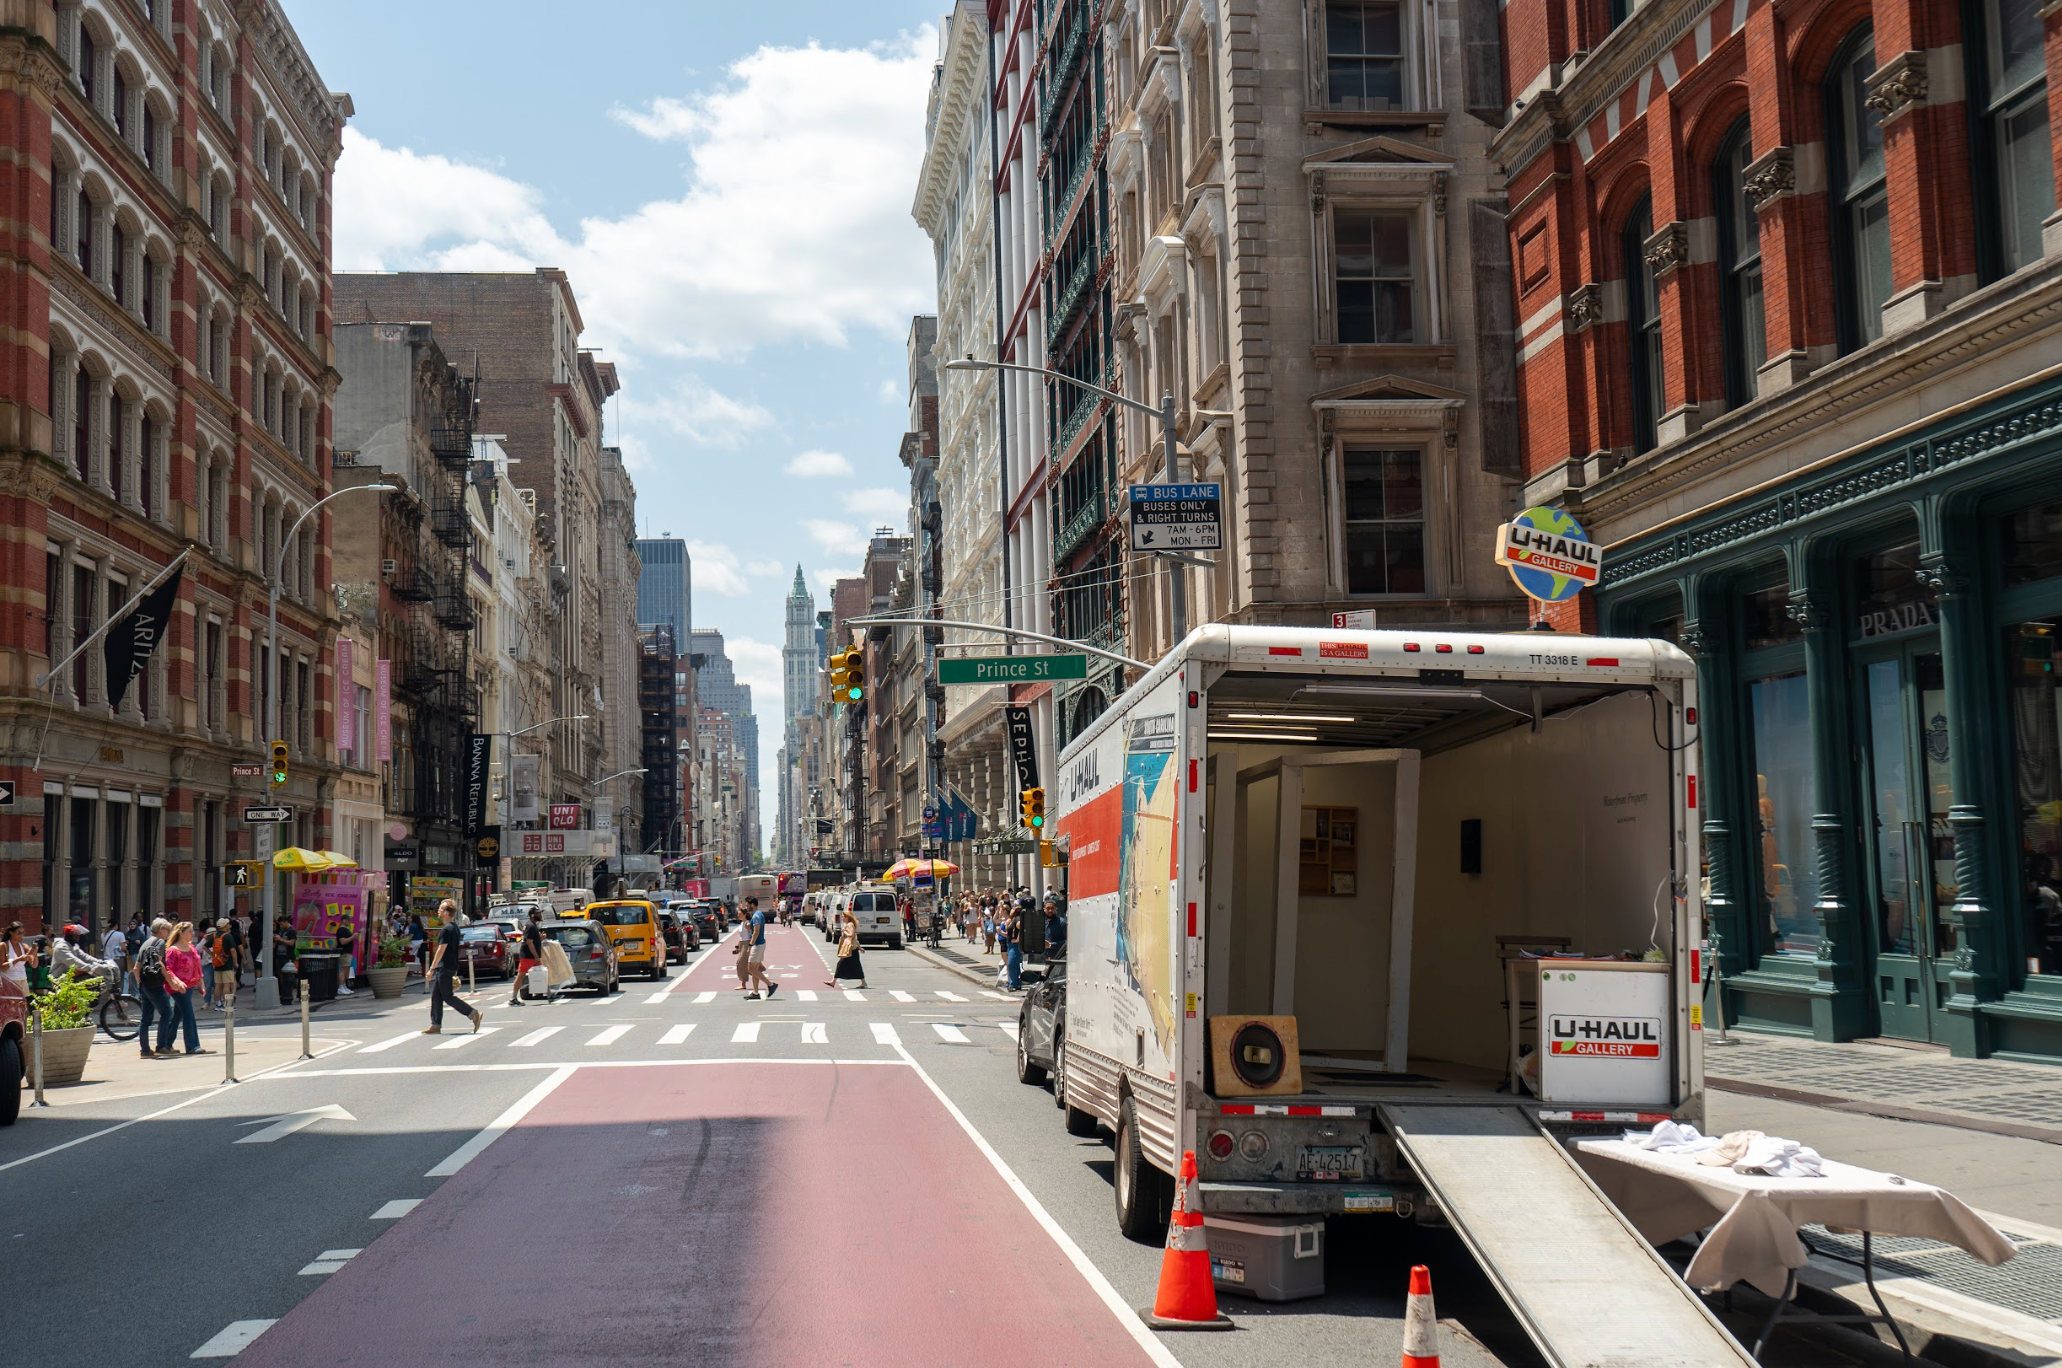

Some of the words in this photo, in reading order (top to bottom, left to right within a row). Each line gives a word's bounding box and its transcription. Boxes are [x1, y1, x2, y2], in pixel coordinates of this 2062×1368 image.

[1154, 487, 1178, 498] BUS
[1182, 486, 1214, 498] LANE
[1143, 502, 1176, 512] BUSES
[1180, 501, 1206, 510] ONLY
[1136, 514, 1144, 523] &
[1148, 513, 1178, 522] RIGHT
[1181, 512, 1214, 522] TURNS
[1166, 526, 1186, 534] 7AM
[1196, 524, 1215, 534] 6PM
[1170, 536, 1190, 546] MON
[1202, 536, 1216, 544] FRI
[1511, 527, 1598, 564] U-HAUL
[1532, 554, 1578, 574] GALLERY
[1336, 615, 1344, 628] 3
[1860, 602, 1934, 638] PRADA
[1529, 654, 1542, 664] TT
[1545, 655, 1568, 665] 3318
[1571, 656, 1578, 665] E
[977, 662, 1027, 678] Prince
[1034, 660, 1049, 676] St
[343, 698, 350, 708] OF
[380, 700, 387, 709] OF
[342, 712, 350, 746] MUSEUM
[470, 738, 484, 781] BANANA
[233, 767, 252, 776] Prince
[253, 767, 260, 775] St
[468, 783, 481, 834] REPUBLIC
[554, 807, 574, 815] UNI
[553, 816, 574, 826] QLO
[1010, 842, 1026, 851] 557
[1554, 1020, 1656, 1040] U-HAUL
[1576, 1043, 1633, 1055] GALLERY
